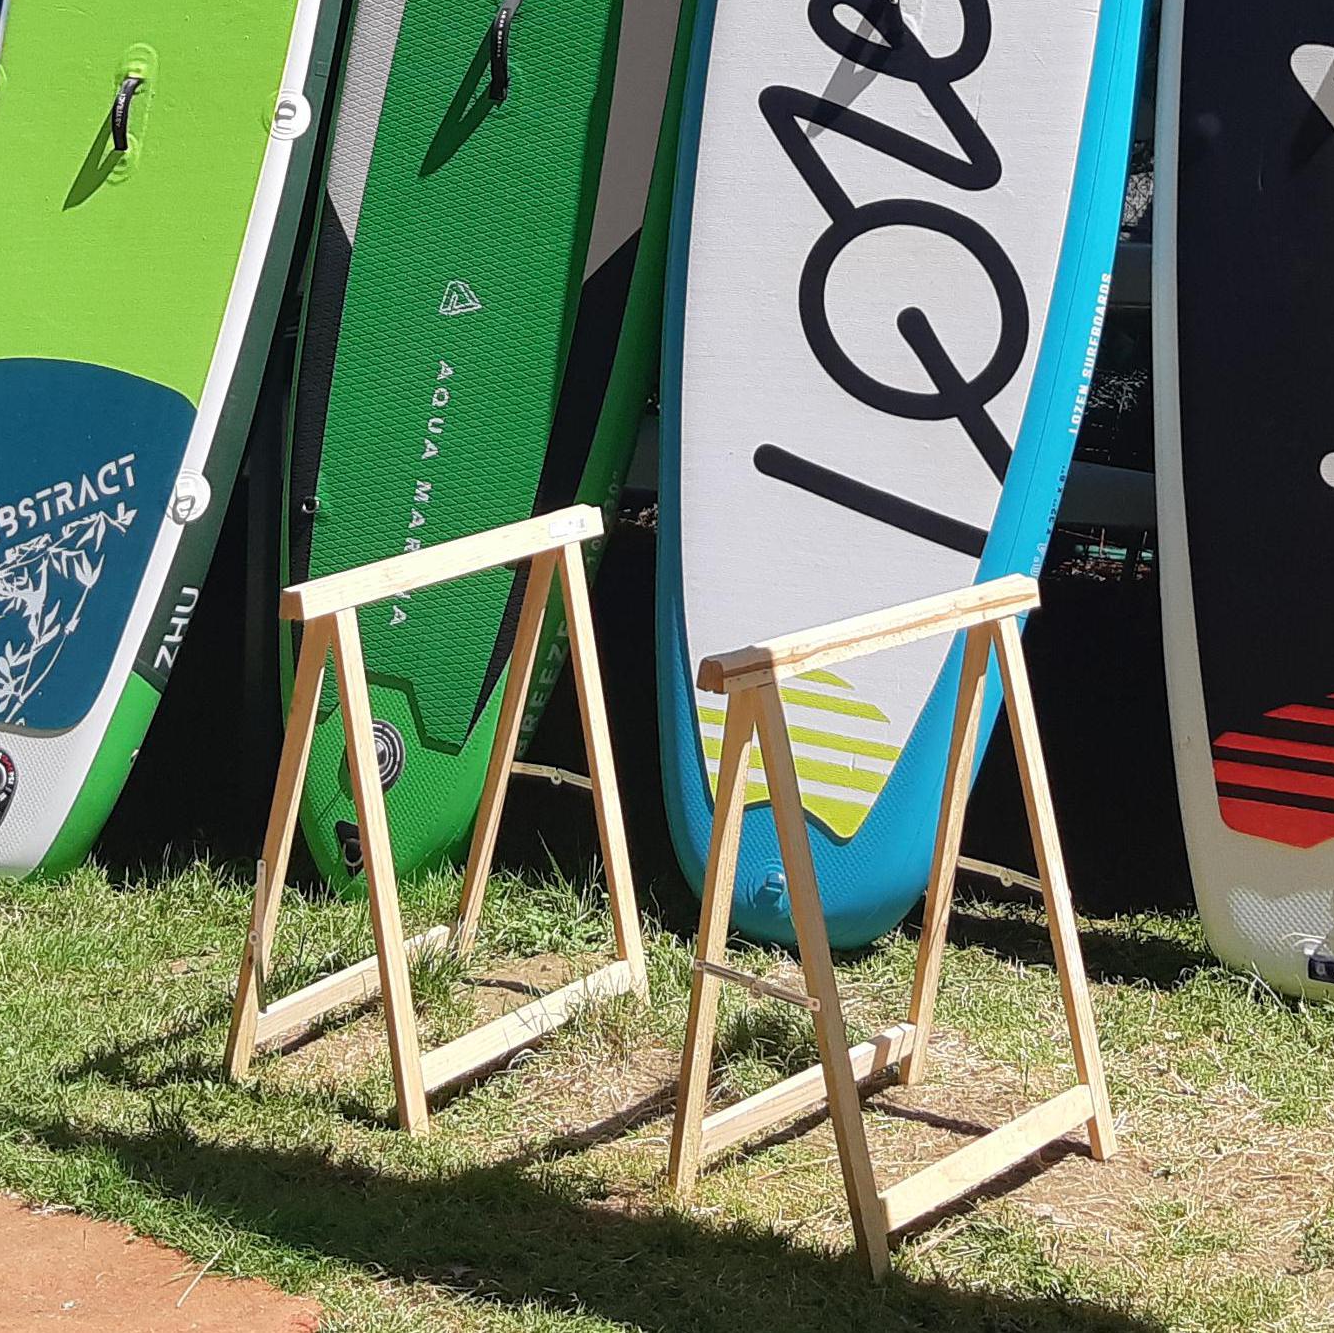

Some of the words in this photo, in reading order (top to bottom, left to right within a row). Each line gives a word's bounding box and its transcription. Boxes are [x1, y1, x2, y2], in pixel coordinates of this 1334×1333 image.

[421, 360, 454, 459] AQUA
[1068, 382, 1090, 435] LOZEN
[1082, 272, 1112, 380] SURFBOARDS
[390, 479, 432, 626] MARA
[153, 586, 200, 669] ZHU
